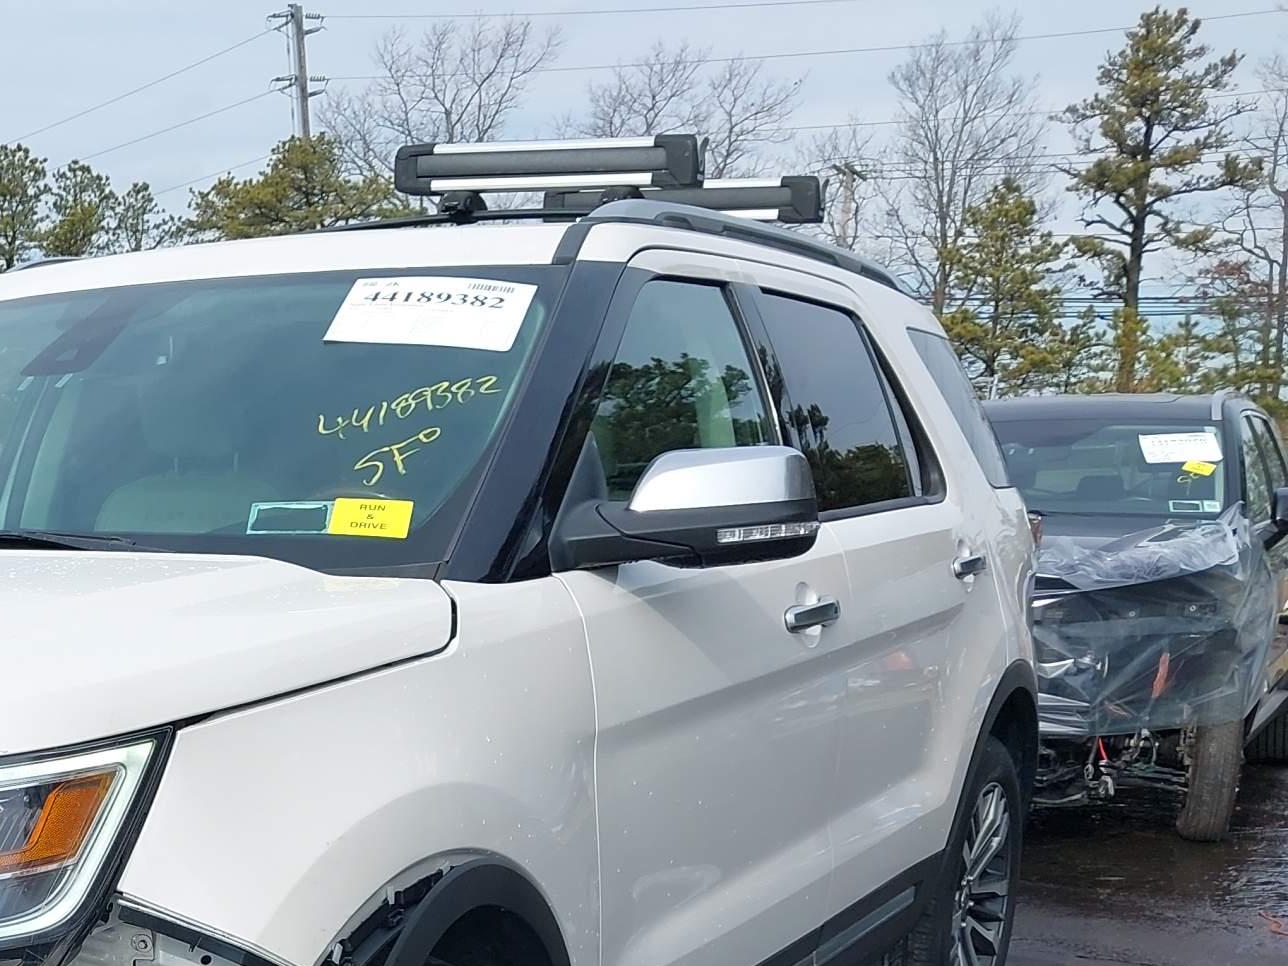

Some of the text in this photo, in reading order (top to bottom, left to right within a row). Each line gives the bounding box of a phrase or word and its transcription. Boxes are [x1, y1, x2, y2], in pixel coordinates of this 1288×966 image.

[363, 290, 506, 309] 44189382
[318, 375, 503, 440] 44189382
[359, 503, 387, 512] RUN
[350, 520, 389, 530] DRIVE
